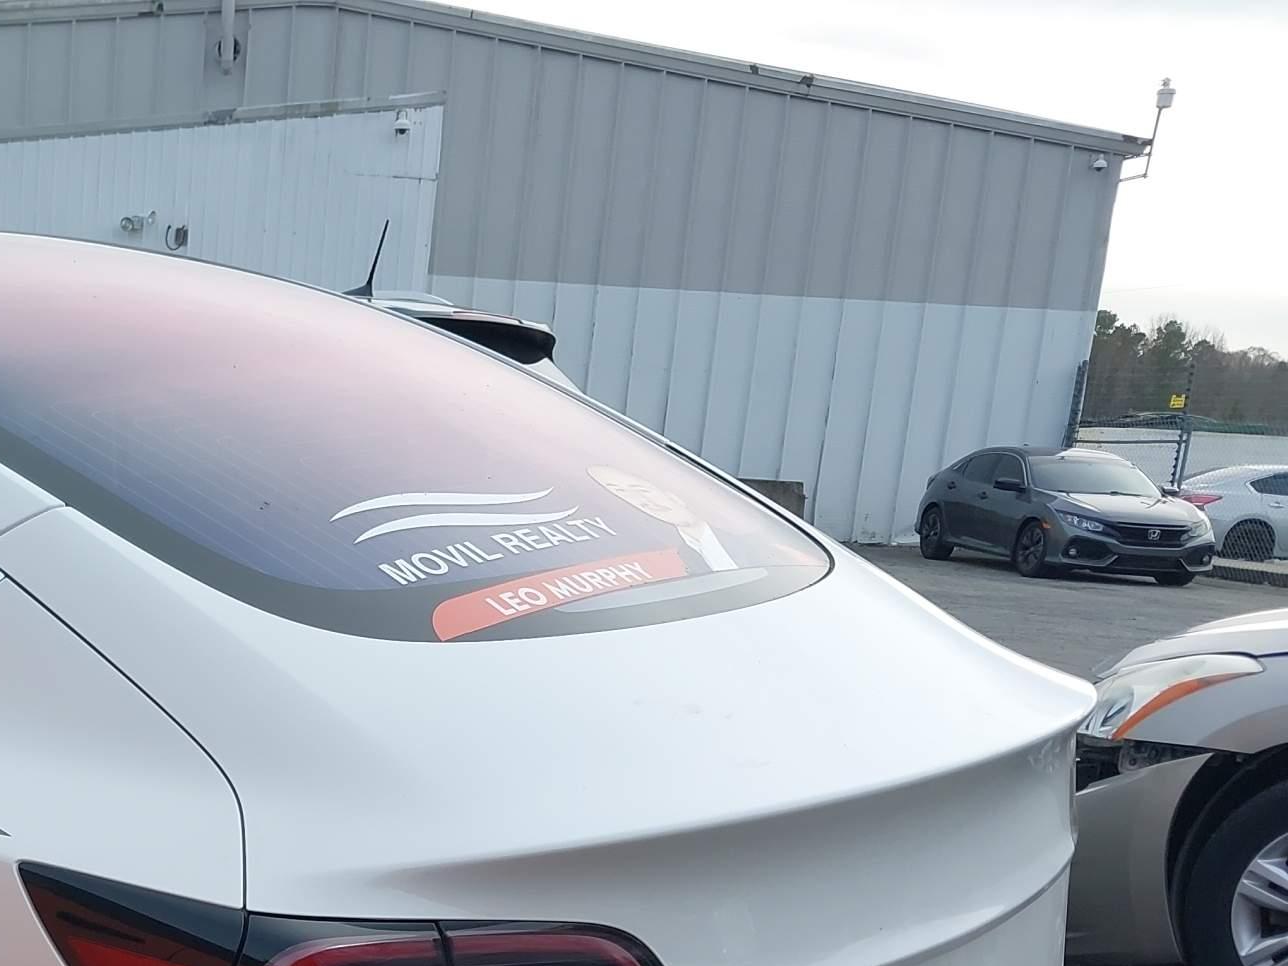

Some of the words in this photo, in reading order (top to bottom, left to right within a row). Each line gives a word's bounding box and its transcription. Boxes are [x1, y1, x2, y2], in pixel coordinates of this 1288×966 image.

[378, 541, 504, 585] MOVIL
[491, 517, 617, 554] REALTY
[485, 587, 549, 616] LEO
[542, 561, 653, 600] MURPHY
